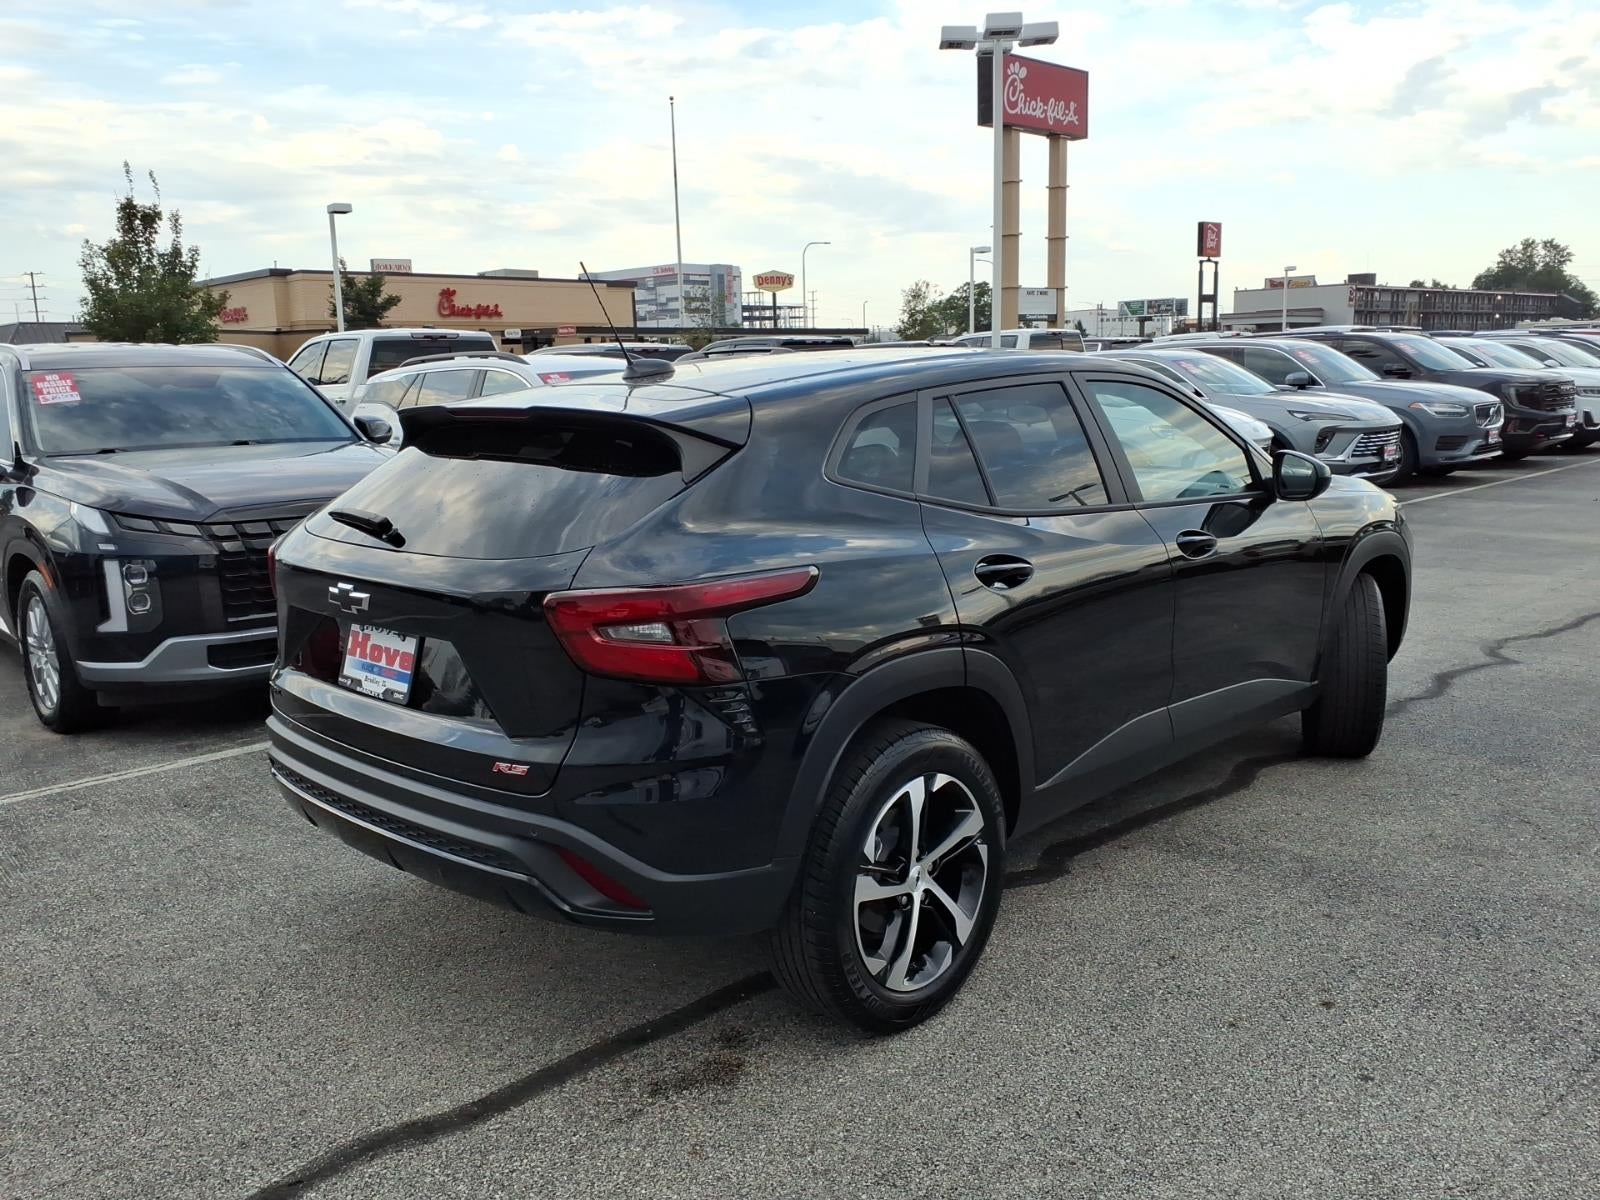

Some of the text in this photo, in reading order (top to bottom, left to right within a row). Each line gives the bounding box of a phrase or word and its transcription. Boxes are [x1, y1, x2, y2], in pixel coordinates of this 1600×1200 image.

[1004, 64, 1079, 126] Chick-fil-A
[757, 274, 793, 287] Denny's
[437, 288, 503, 319] Chick-fil-A
[36, 379, 73, 388] HASSLE
[42, 385, 73, 395] PRICE
[492, 761, 531, 776] RS
